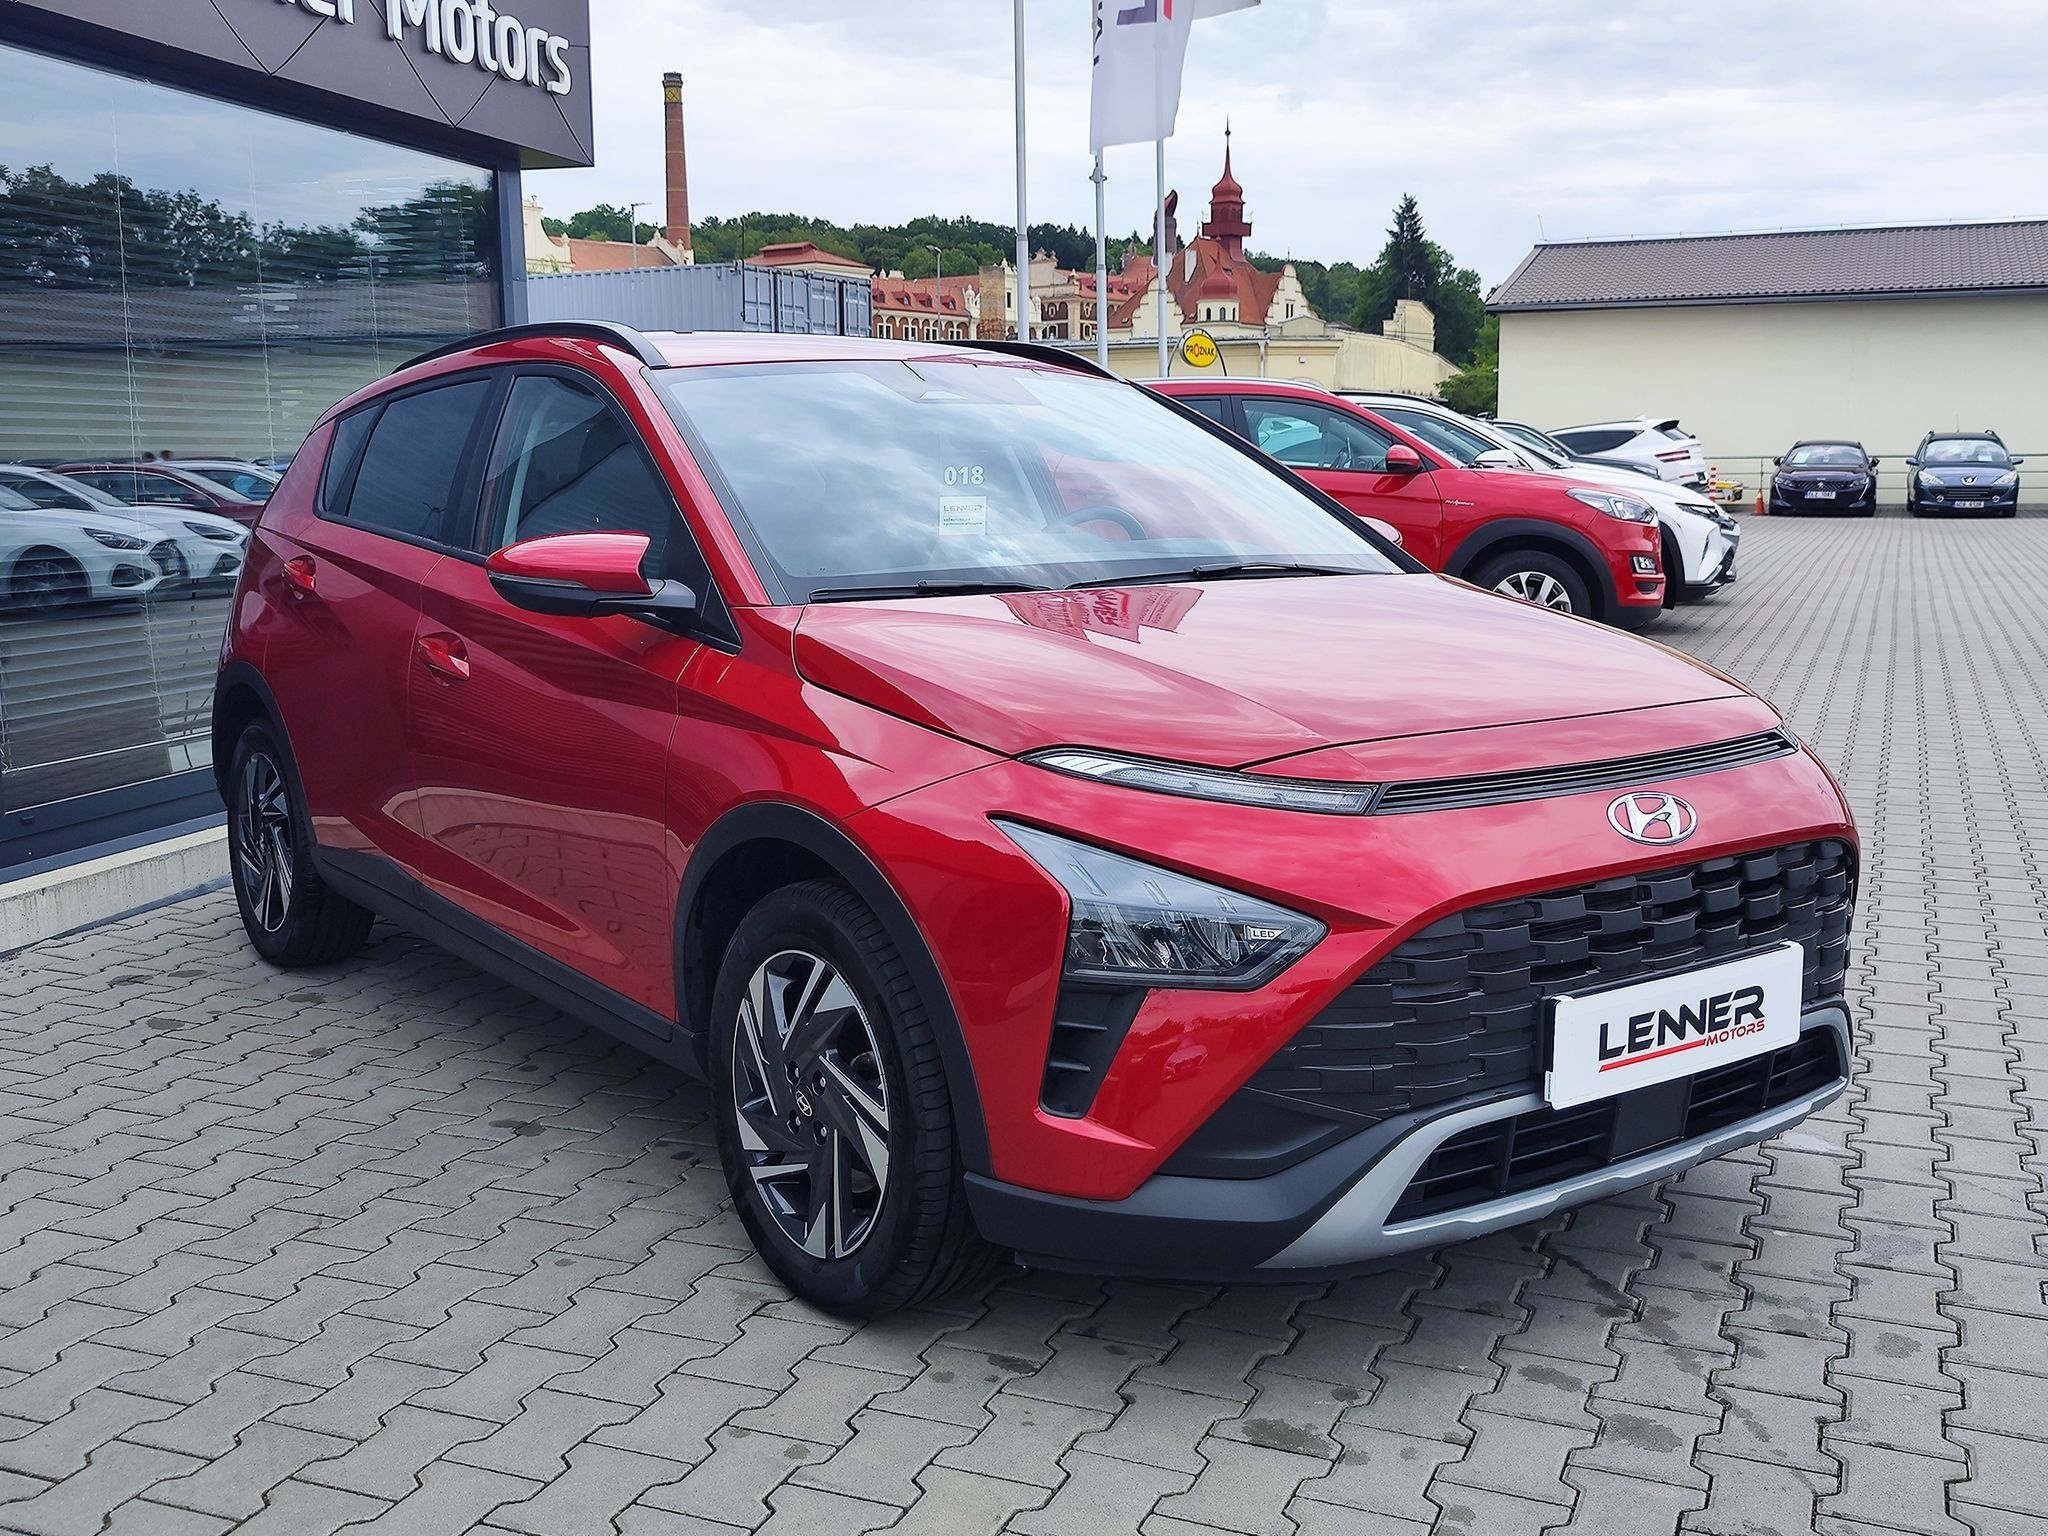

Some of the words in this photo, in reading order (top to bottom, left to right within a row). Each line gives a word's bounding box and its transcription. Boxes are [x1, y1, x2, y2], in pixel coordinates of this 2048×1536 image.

[386, 0, 572, 95] Motors
[944, 465, 984, 486] 018
[1253, 930, 1276, 938] LED
[1598, 985, 1765, 1062] LENNER
[1705, 1019, 1765, 1047] MOTORS
